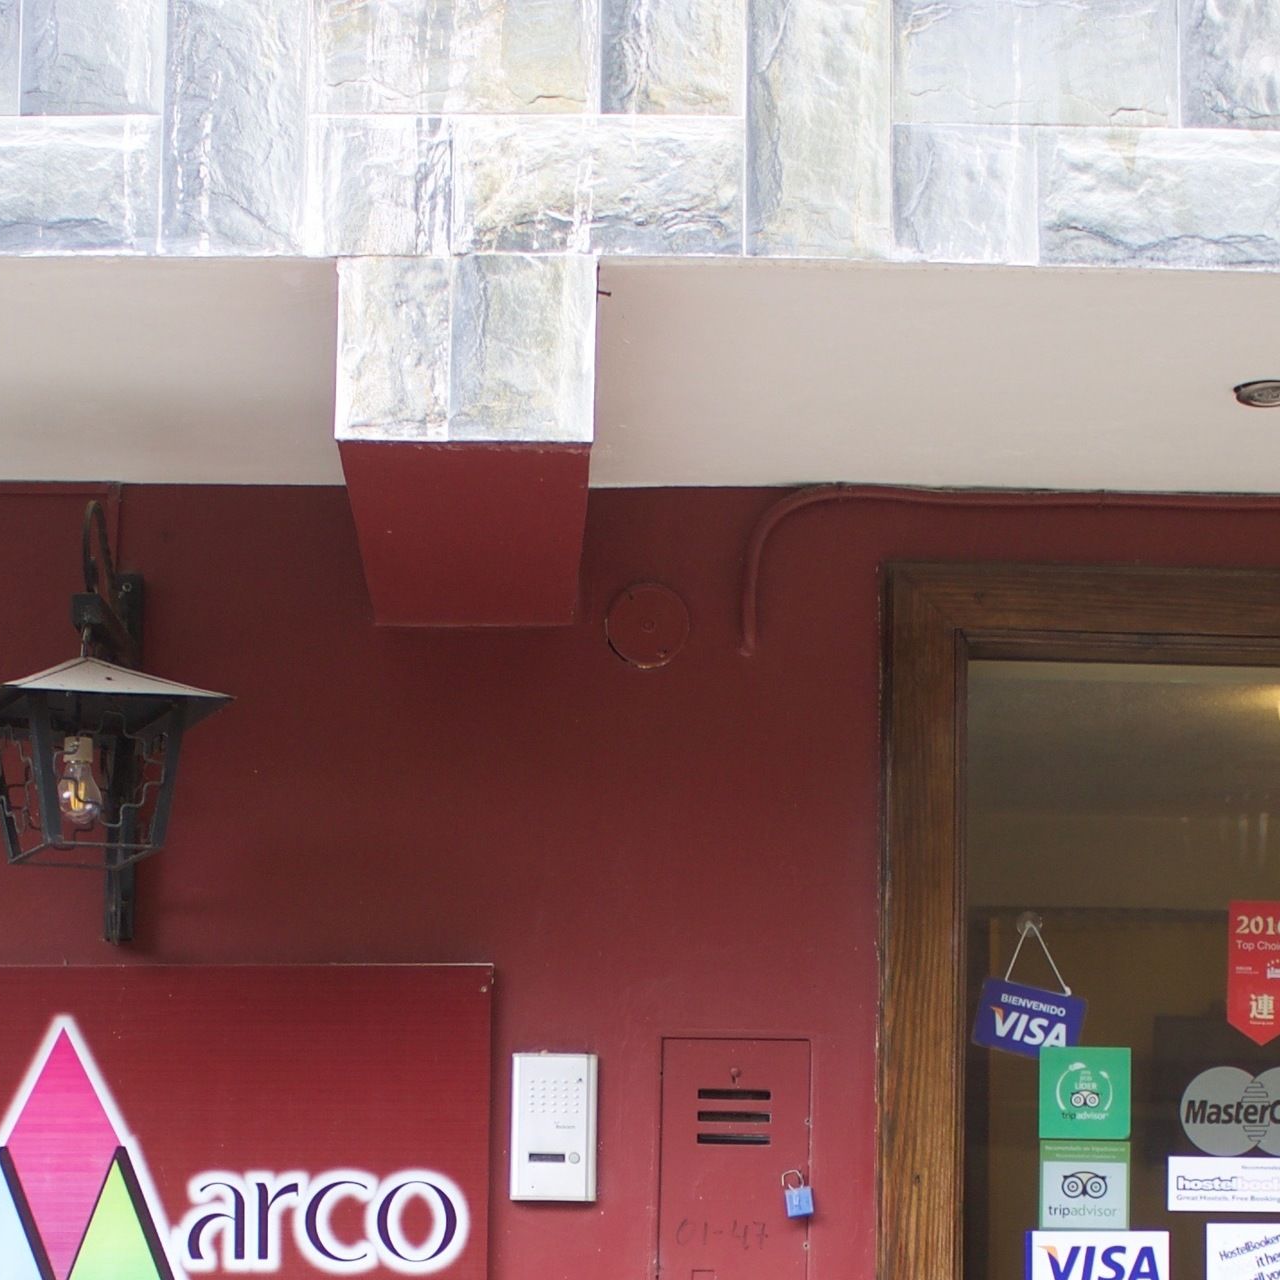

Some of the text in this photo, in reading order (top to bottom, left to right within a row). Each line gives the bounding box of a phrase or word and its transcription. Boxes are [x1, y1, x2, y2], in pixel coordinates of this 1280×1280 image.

[1235, 940, 1253, 952] Top
[1000, 993, 1066, 1017] BIENVENIDO
[990, 1005, 1067, 1048] VISA
[1048, 1204, 1117, 1219] tripadvisor
